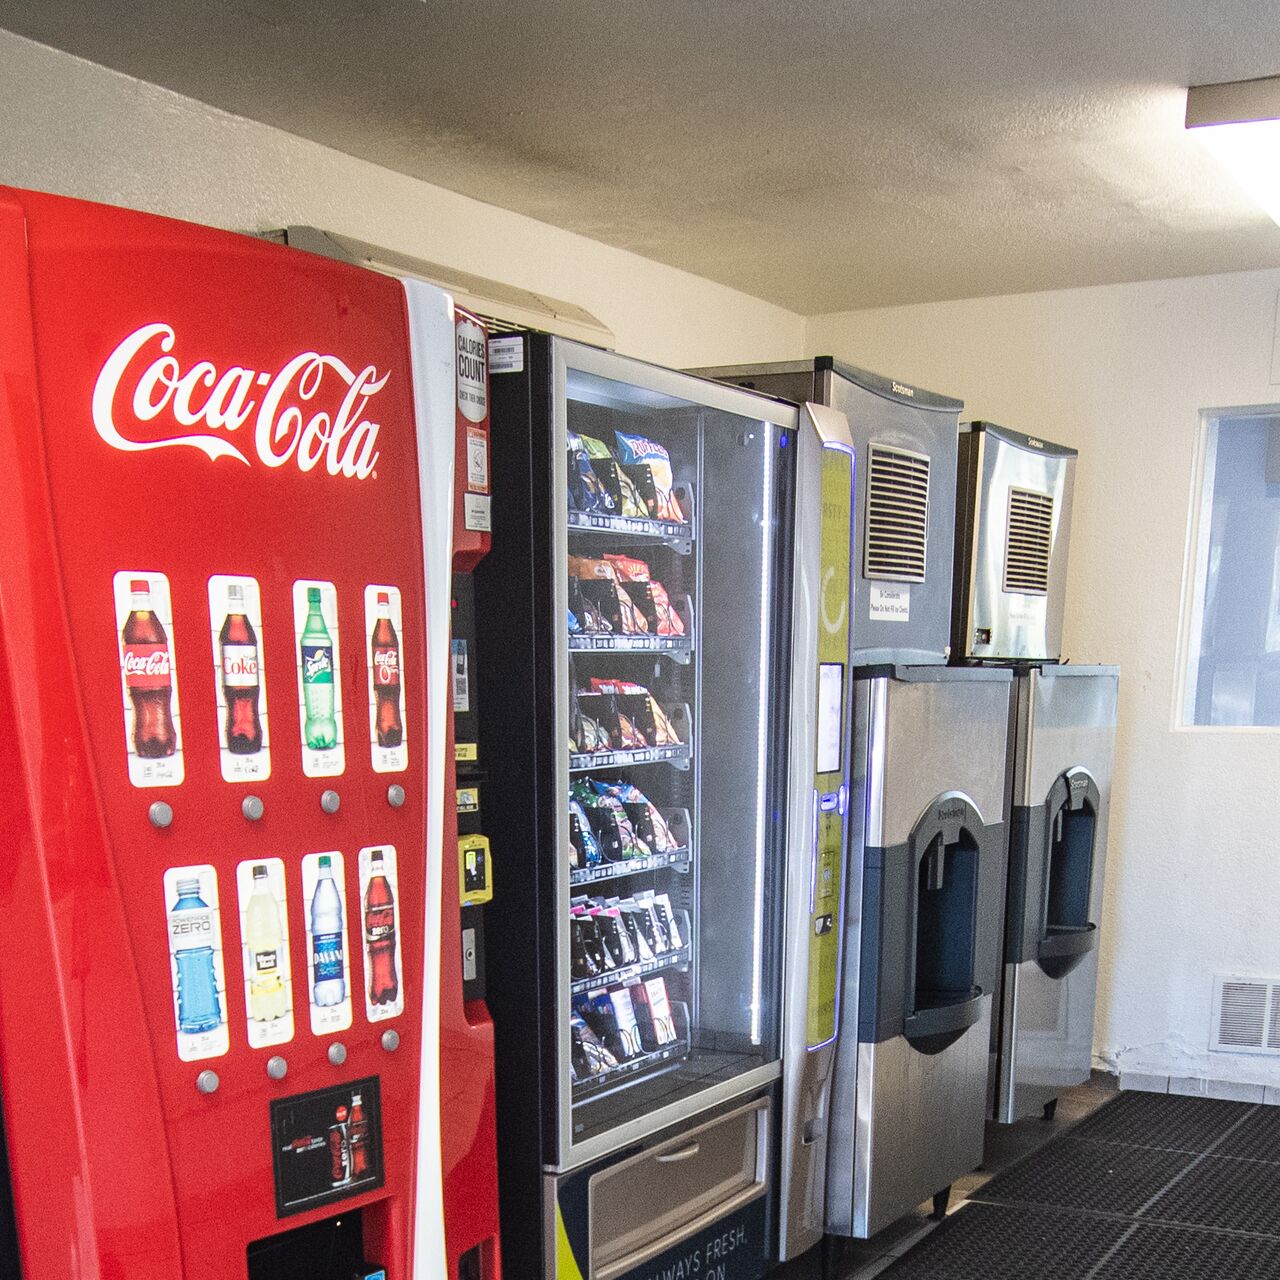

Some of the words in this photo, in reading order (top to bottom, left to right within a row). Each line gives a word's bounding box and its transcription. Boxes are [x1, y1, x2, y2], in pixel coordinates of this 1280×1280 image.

[458, 335, 485, 359] CALORIES
[458, 354, 485, 384] COUNT
[892, 381, 914, 397] Scotsman
[92, 322, 392, 480] Coca-Cola
[224, 656, 258, 675] Coke
[306, 656, 330, 677] Sprite
[172, 920, 212, 936] ZERO
[371, 925, 389, 936] zero
